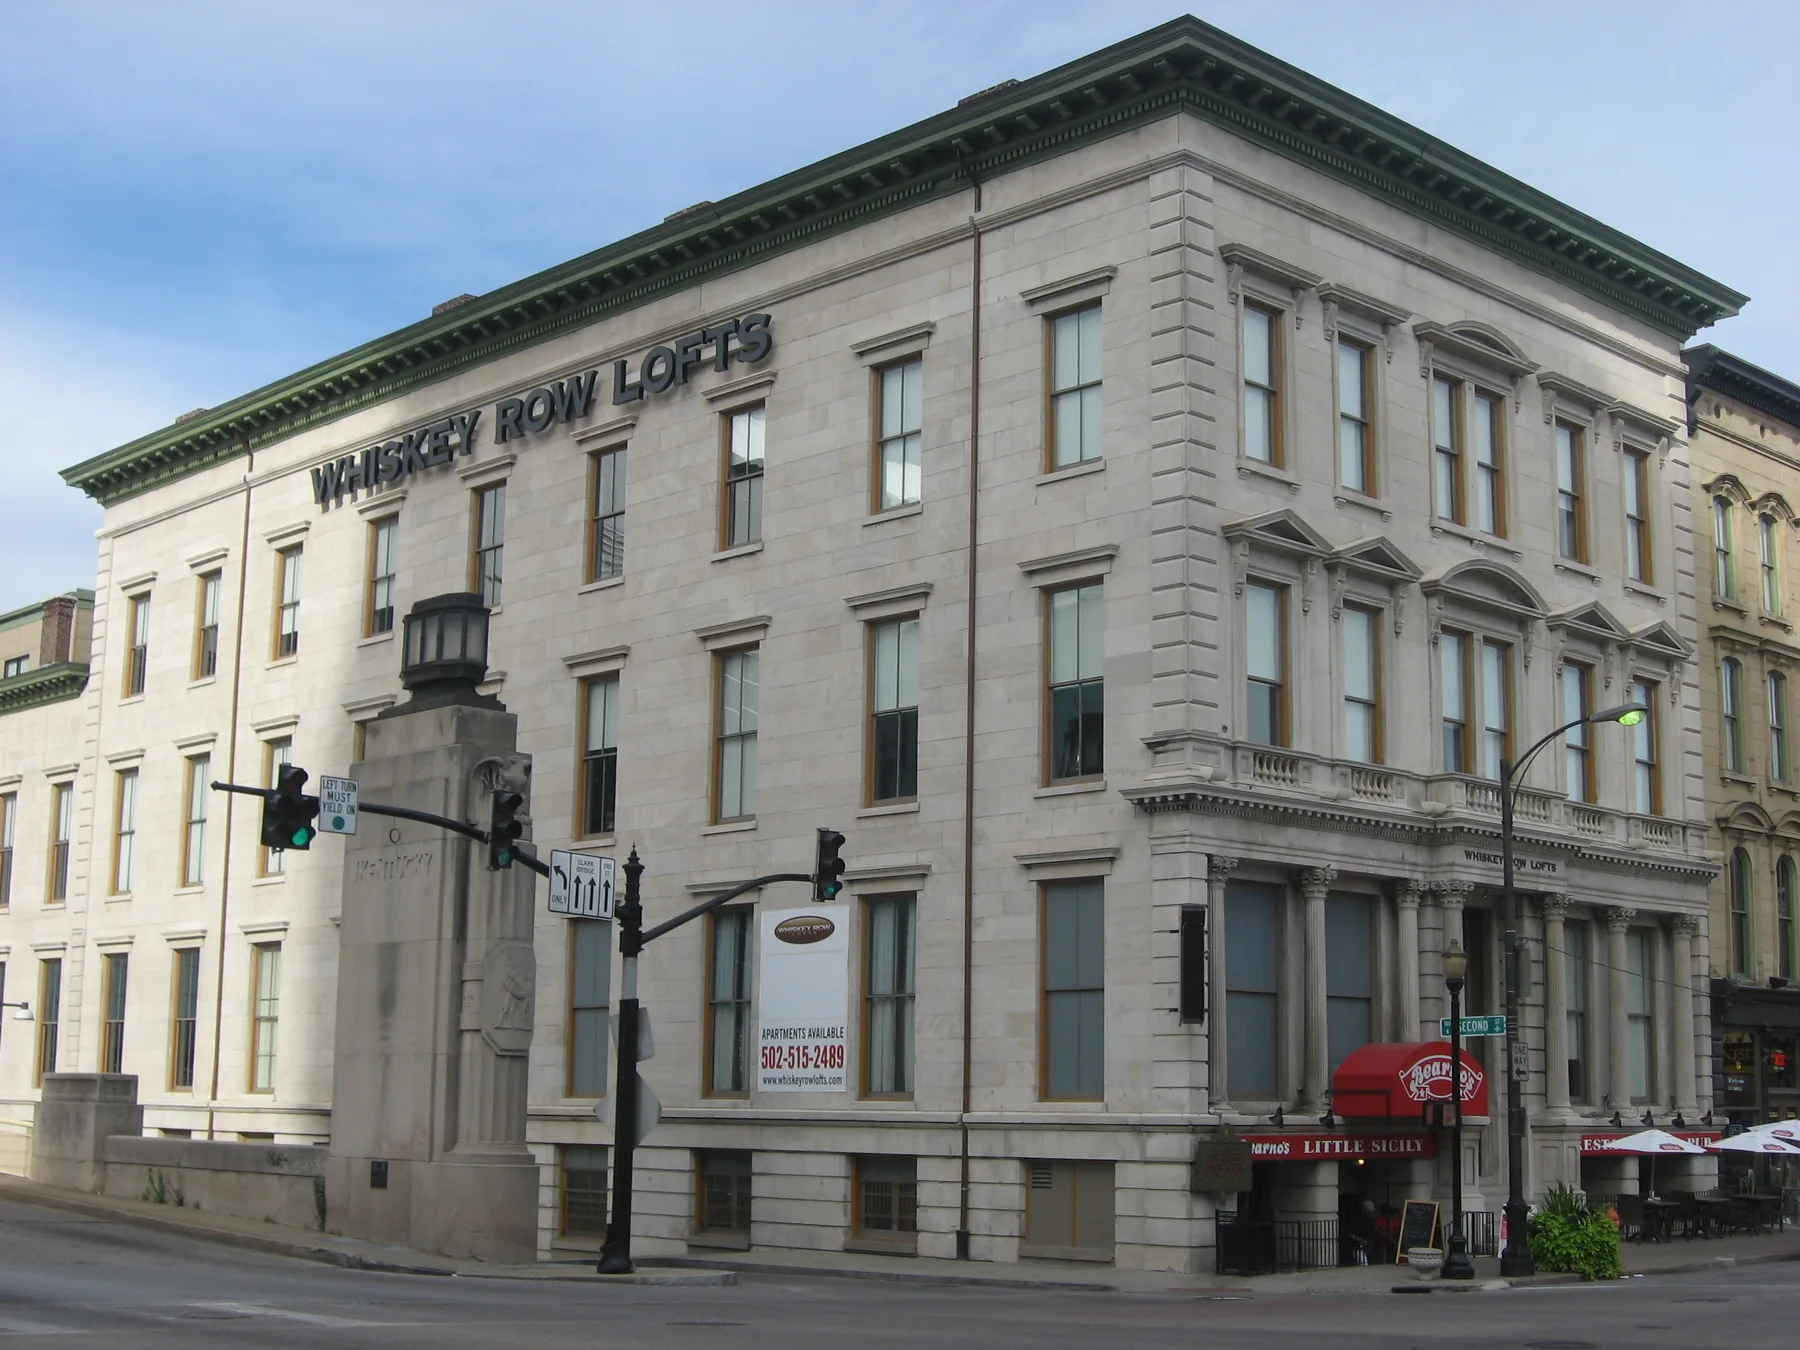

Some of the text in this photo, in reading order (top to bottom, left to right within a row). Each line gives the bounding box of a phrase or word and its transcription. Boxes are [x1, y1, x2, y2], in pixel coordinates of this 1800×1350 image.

[310, 313, 773, 502] WHISKEY ROW LOFTS
[322, 778, 357, 792] LEFT TURN
[327, 791, 351, 803] MUST
[322, 801, 356, 815] YIELD ON
[577, 859, 594, 867] CLARK
[1464, 849, 1557, 872] WHISKEY OW LOFTS
[551, 894, 568, 905] ONLY
[778, 925, 812, 933] WHISKEY
[1459, 1020, 1488, 1032] SECOND
[762, 1026, 844, 1040] APARTMENTS AVAILABLE
[761, 1044, 844, 1069] 502-515-2489
[1513, 1045, 1527, 1055] ONE
[1513, 1056, 1527, 1066] WAY
[762, 1074, 843, 1087] www.whiskeyrowlofts.com
[1304, 1140, 1364, 1153] LITTLE
[1371, 1139, 1424, 1152] SICILY
